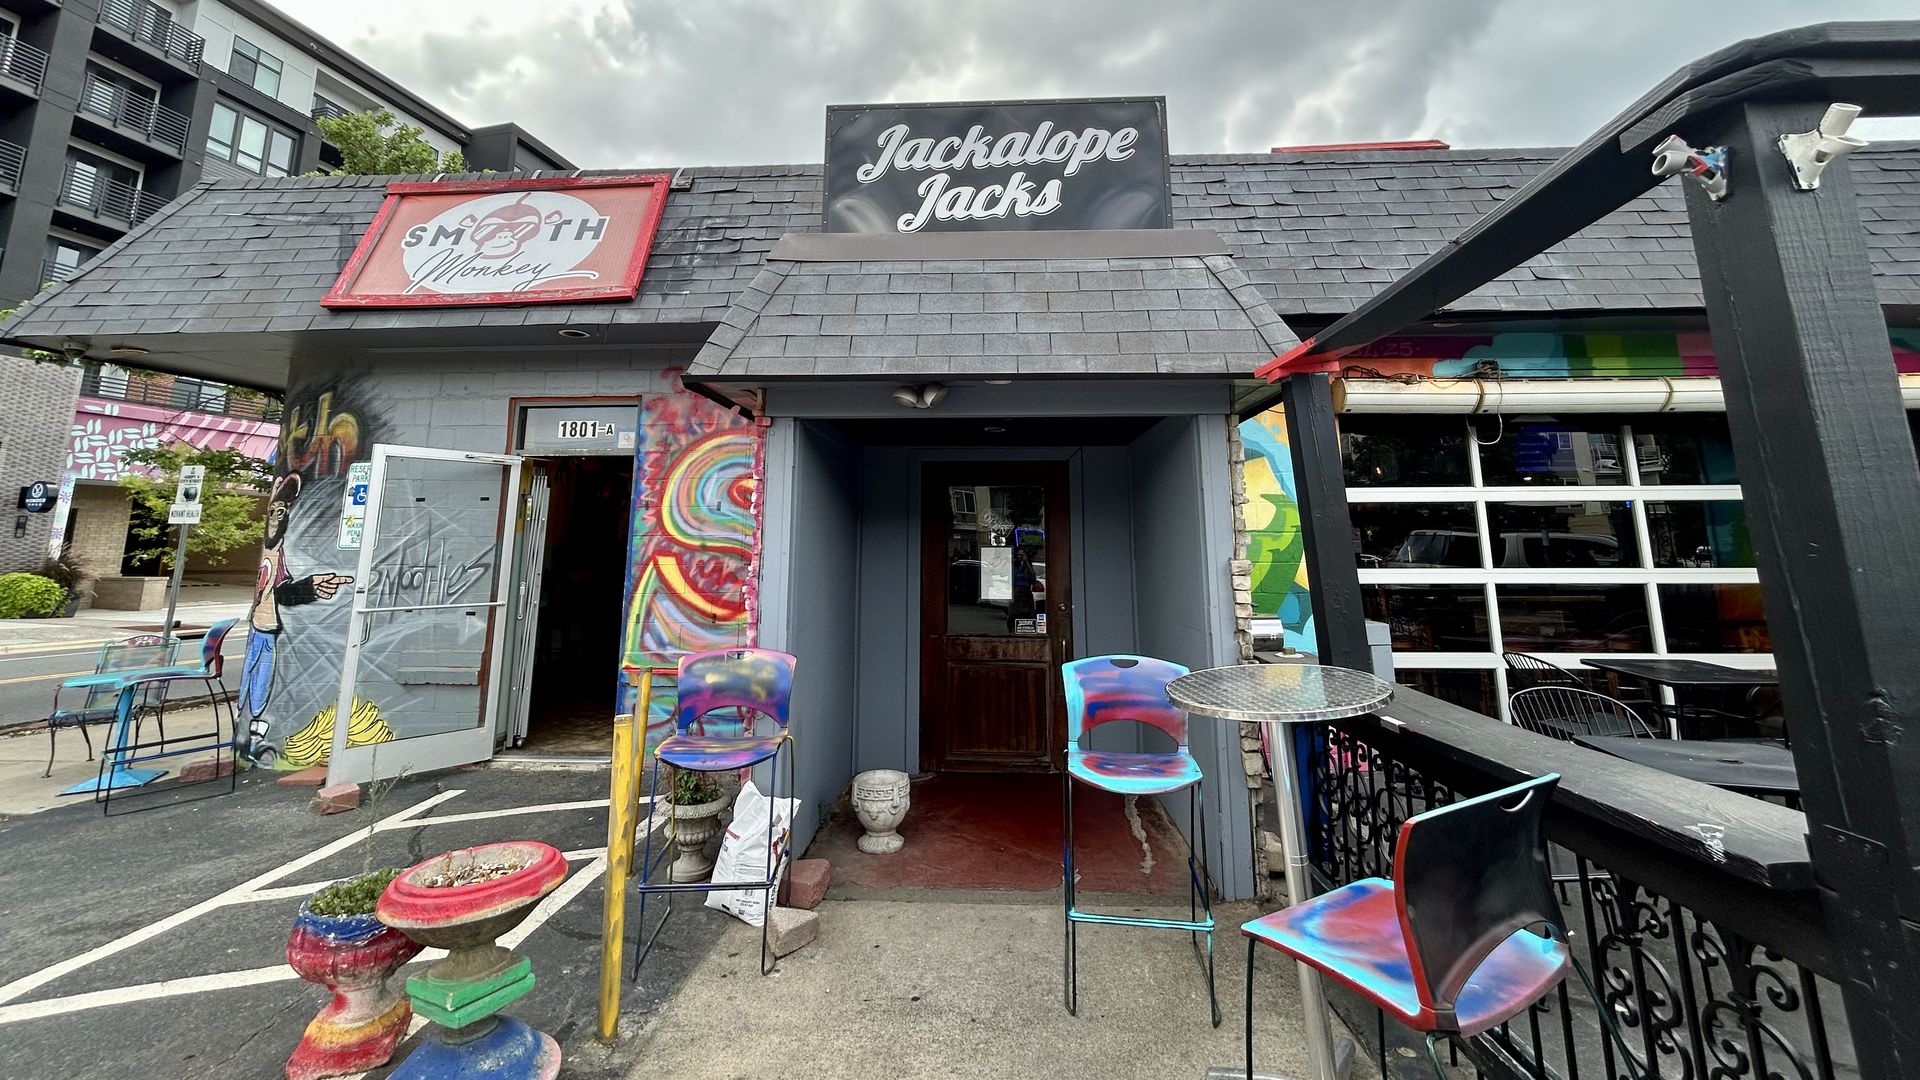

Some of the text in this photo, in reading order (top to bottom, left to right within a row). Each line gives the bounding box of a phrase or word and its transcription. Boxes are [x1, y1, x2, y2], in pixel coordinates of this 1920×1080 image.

[857, 120, 1139, 183] Jackalope
[897, 171, 1063, 233] Jacks
[411, 248, 595, 292] Monkey
[350, 465, 372, 473] RESER
[352, 474, 369, 482] PARK
